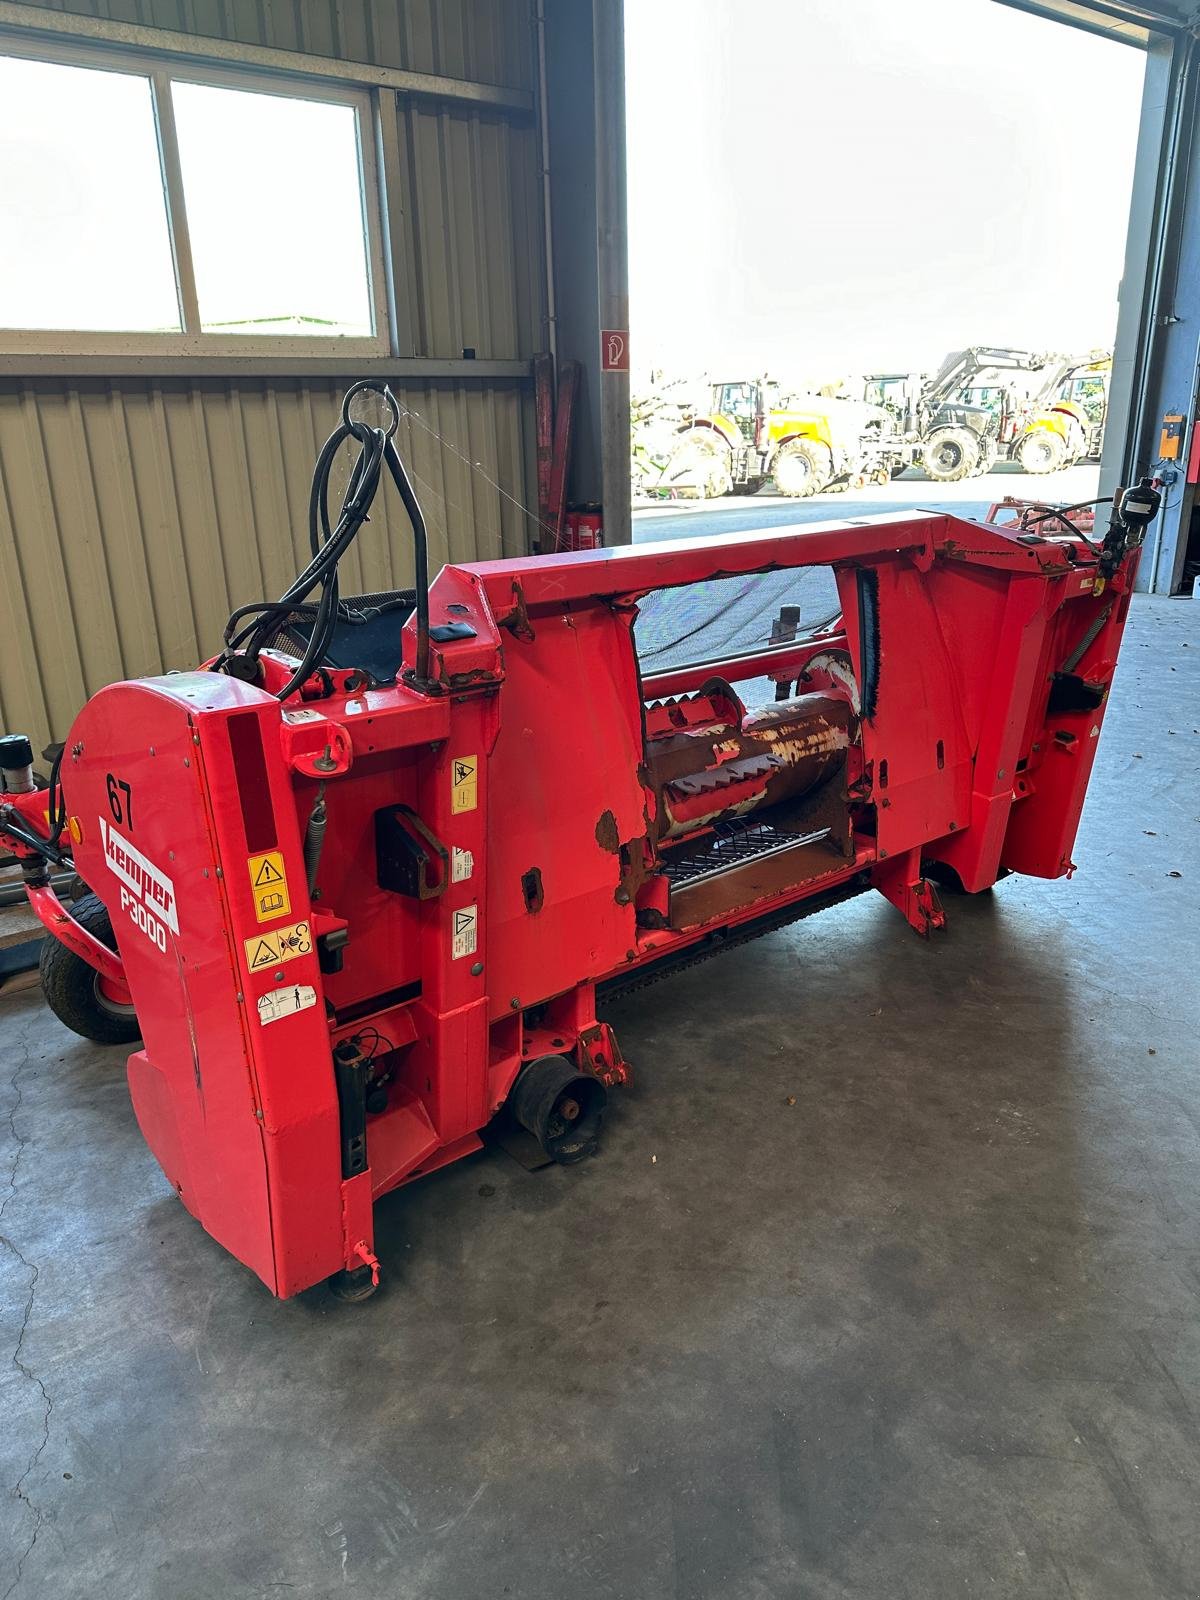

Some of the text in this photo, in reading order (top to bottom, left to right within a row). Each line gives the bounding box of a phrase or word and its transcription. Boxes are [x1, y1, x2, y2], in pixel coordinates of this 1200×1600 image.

[106, 773, 133, 831] 67
[105, 821, 174, 913] kemper
[120, 885, 167, 954] P3000
